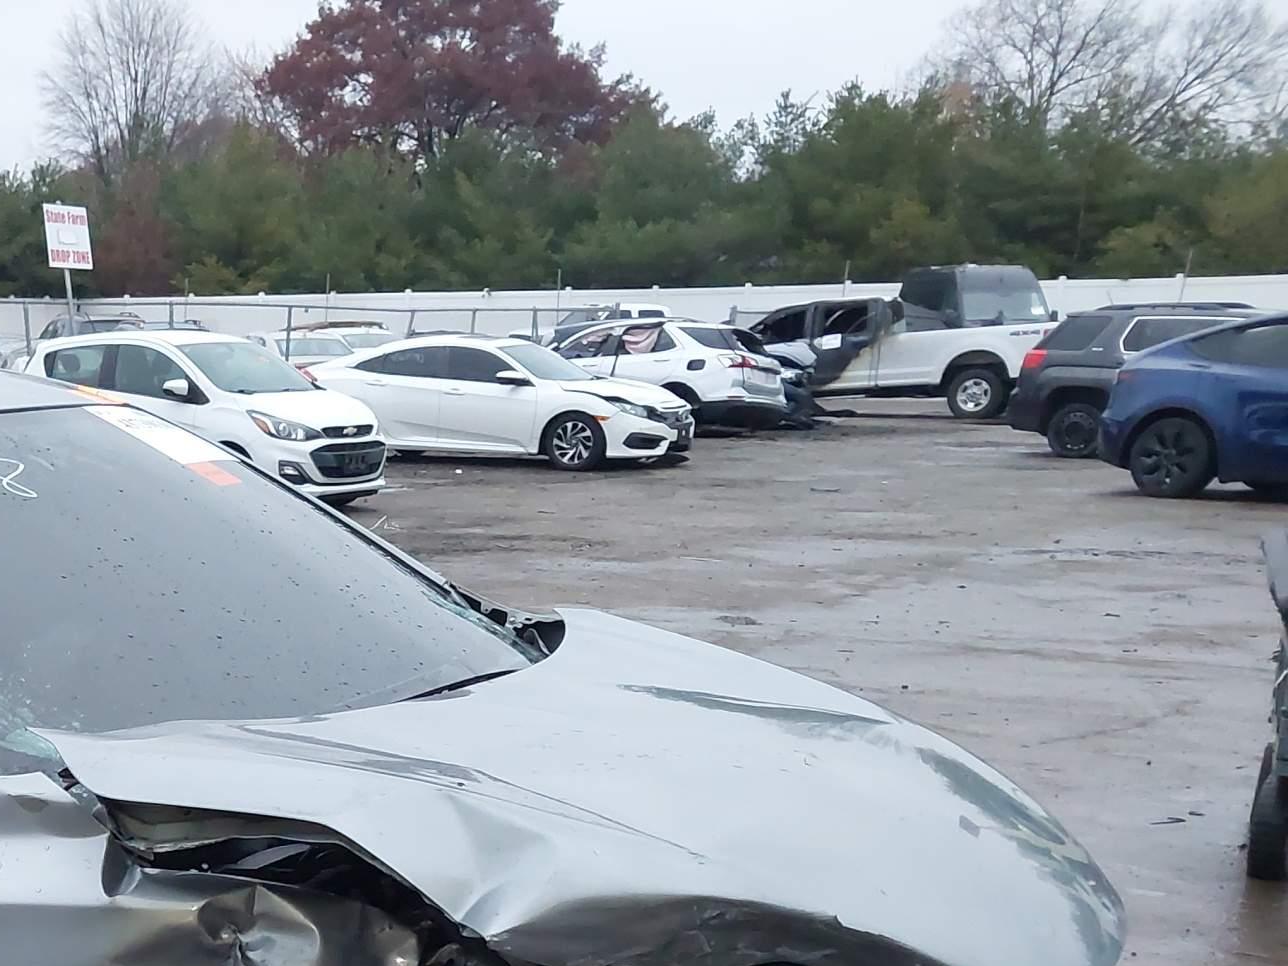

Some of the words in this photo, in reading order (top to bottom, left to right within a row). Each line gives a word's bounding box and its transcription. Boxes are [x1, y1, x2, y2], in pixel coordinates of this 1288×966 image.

[45, 209, 66, 224] State
[67, 211, 87, 225] Farm
[50, 248, 70, 262] DROP
[72, 250, 90, 264] ZONE
